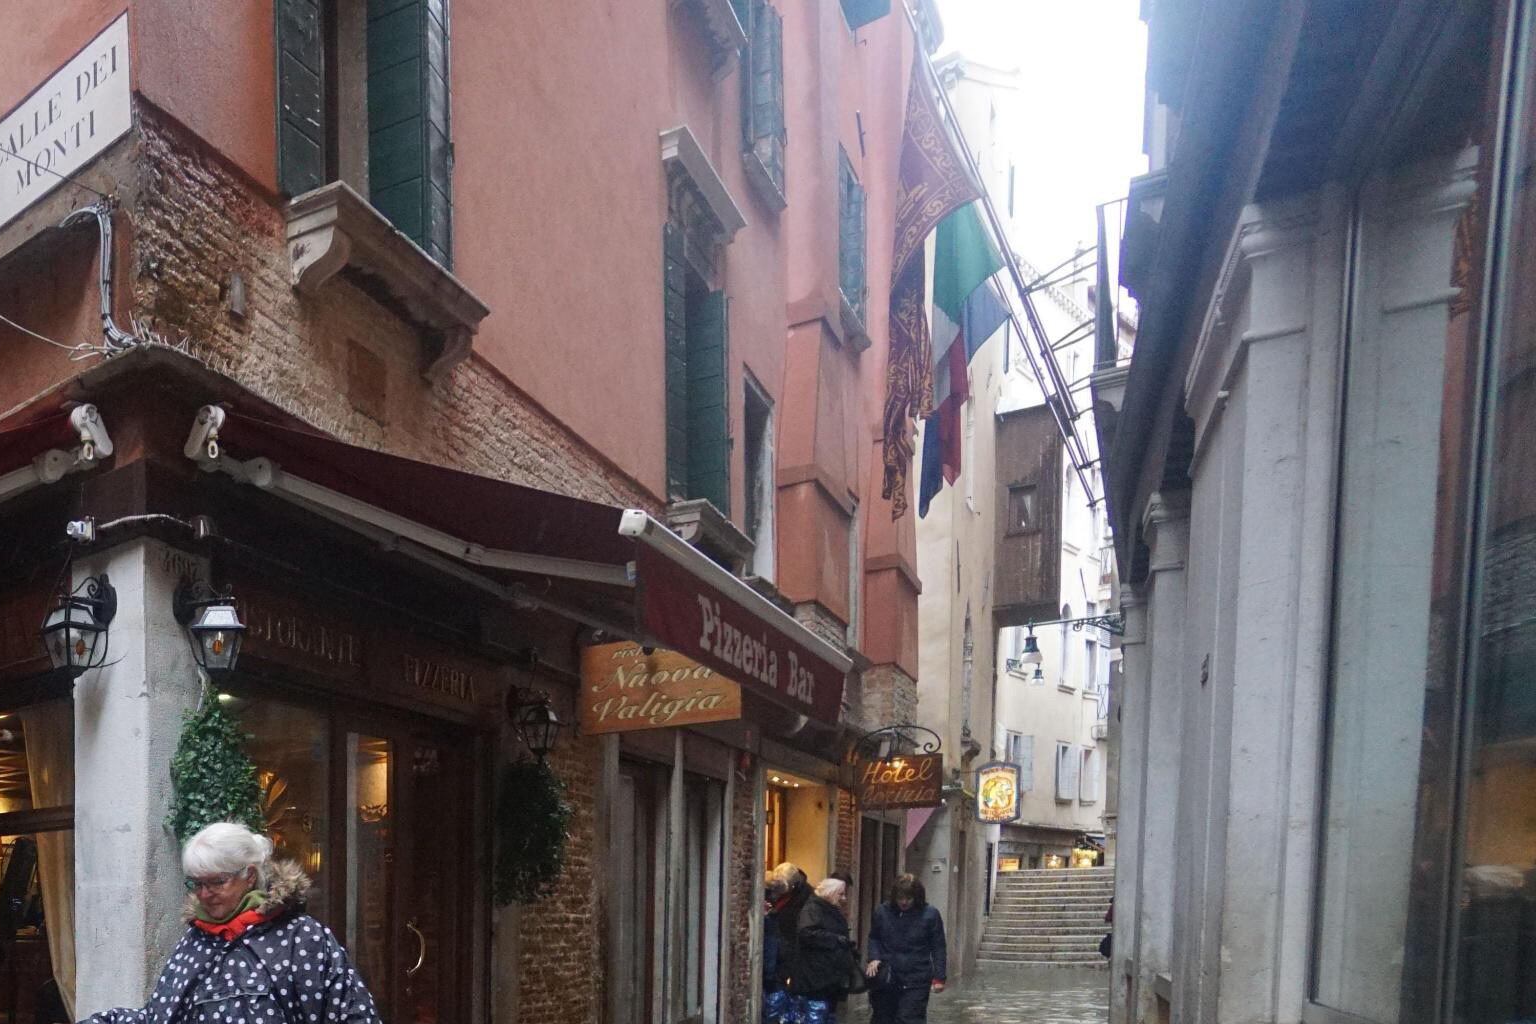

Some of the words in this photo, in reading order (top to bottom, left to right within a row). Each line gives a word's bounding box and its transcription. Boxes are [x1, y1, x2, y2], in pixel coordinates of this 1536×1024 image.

[75, 46, 117, 104] DEI
[16, 110, 95, 195] MONTI
[698, 593, 778, 688] Pizzeria
[787, 651, 814, 704] Bar
[402, 653, 475, 702] PIZZERIA
[592, 662, 716, 692] Nuova
[592, 690, 725, 725] Valigia
[861, 757, 934, 784] Hotel
